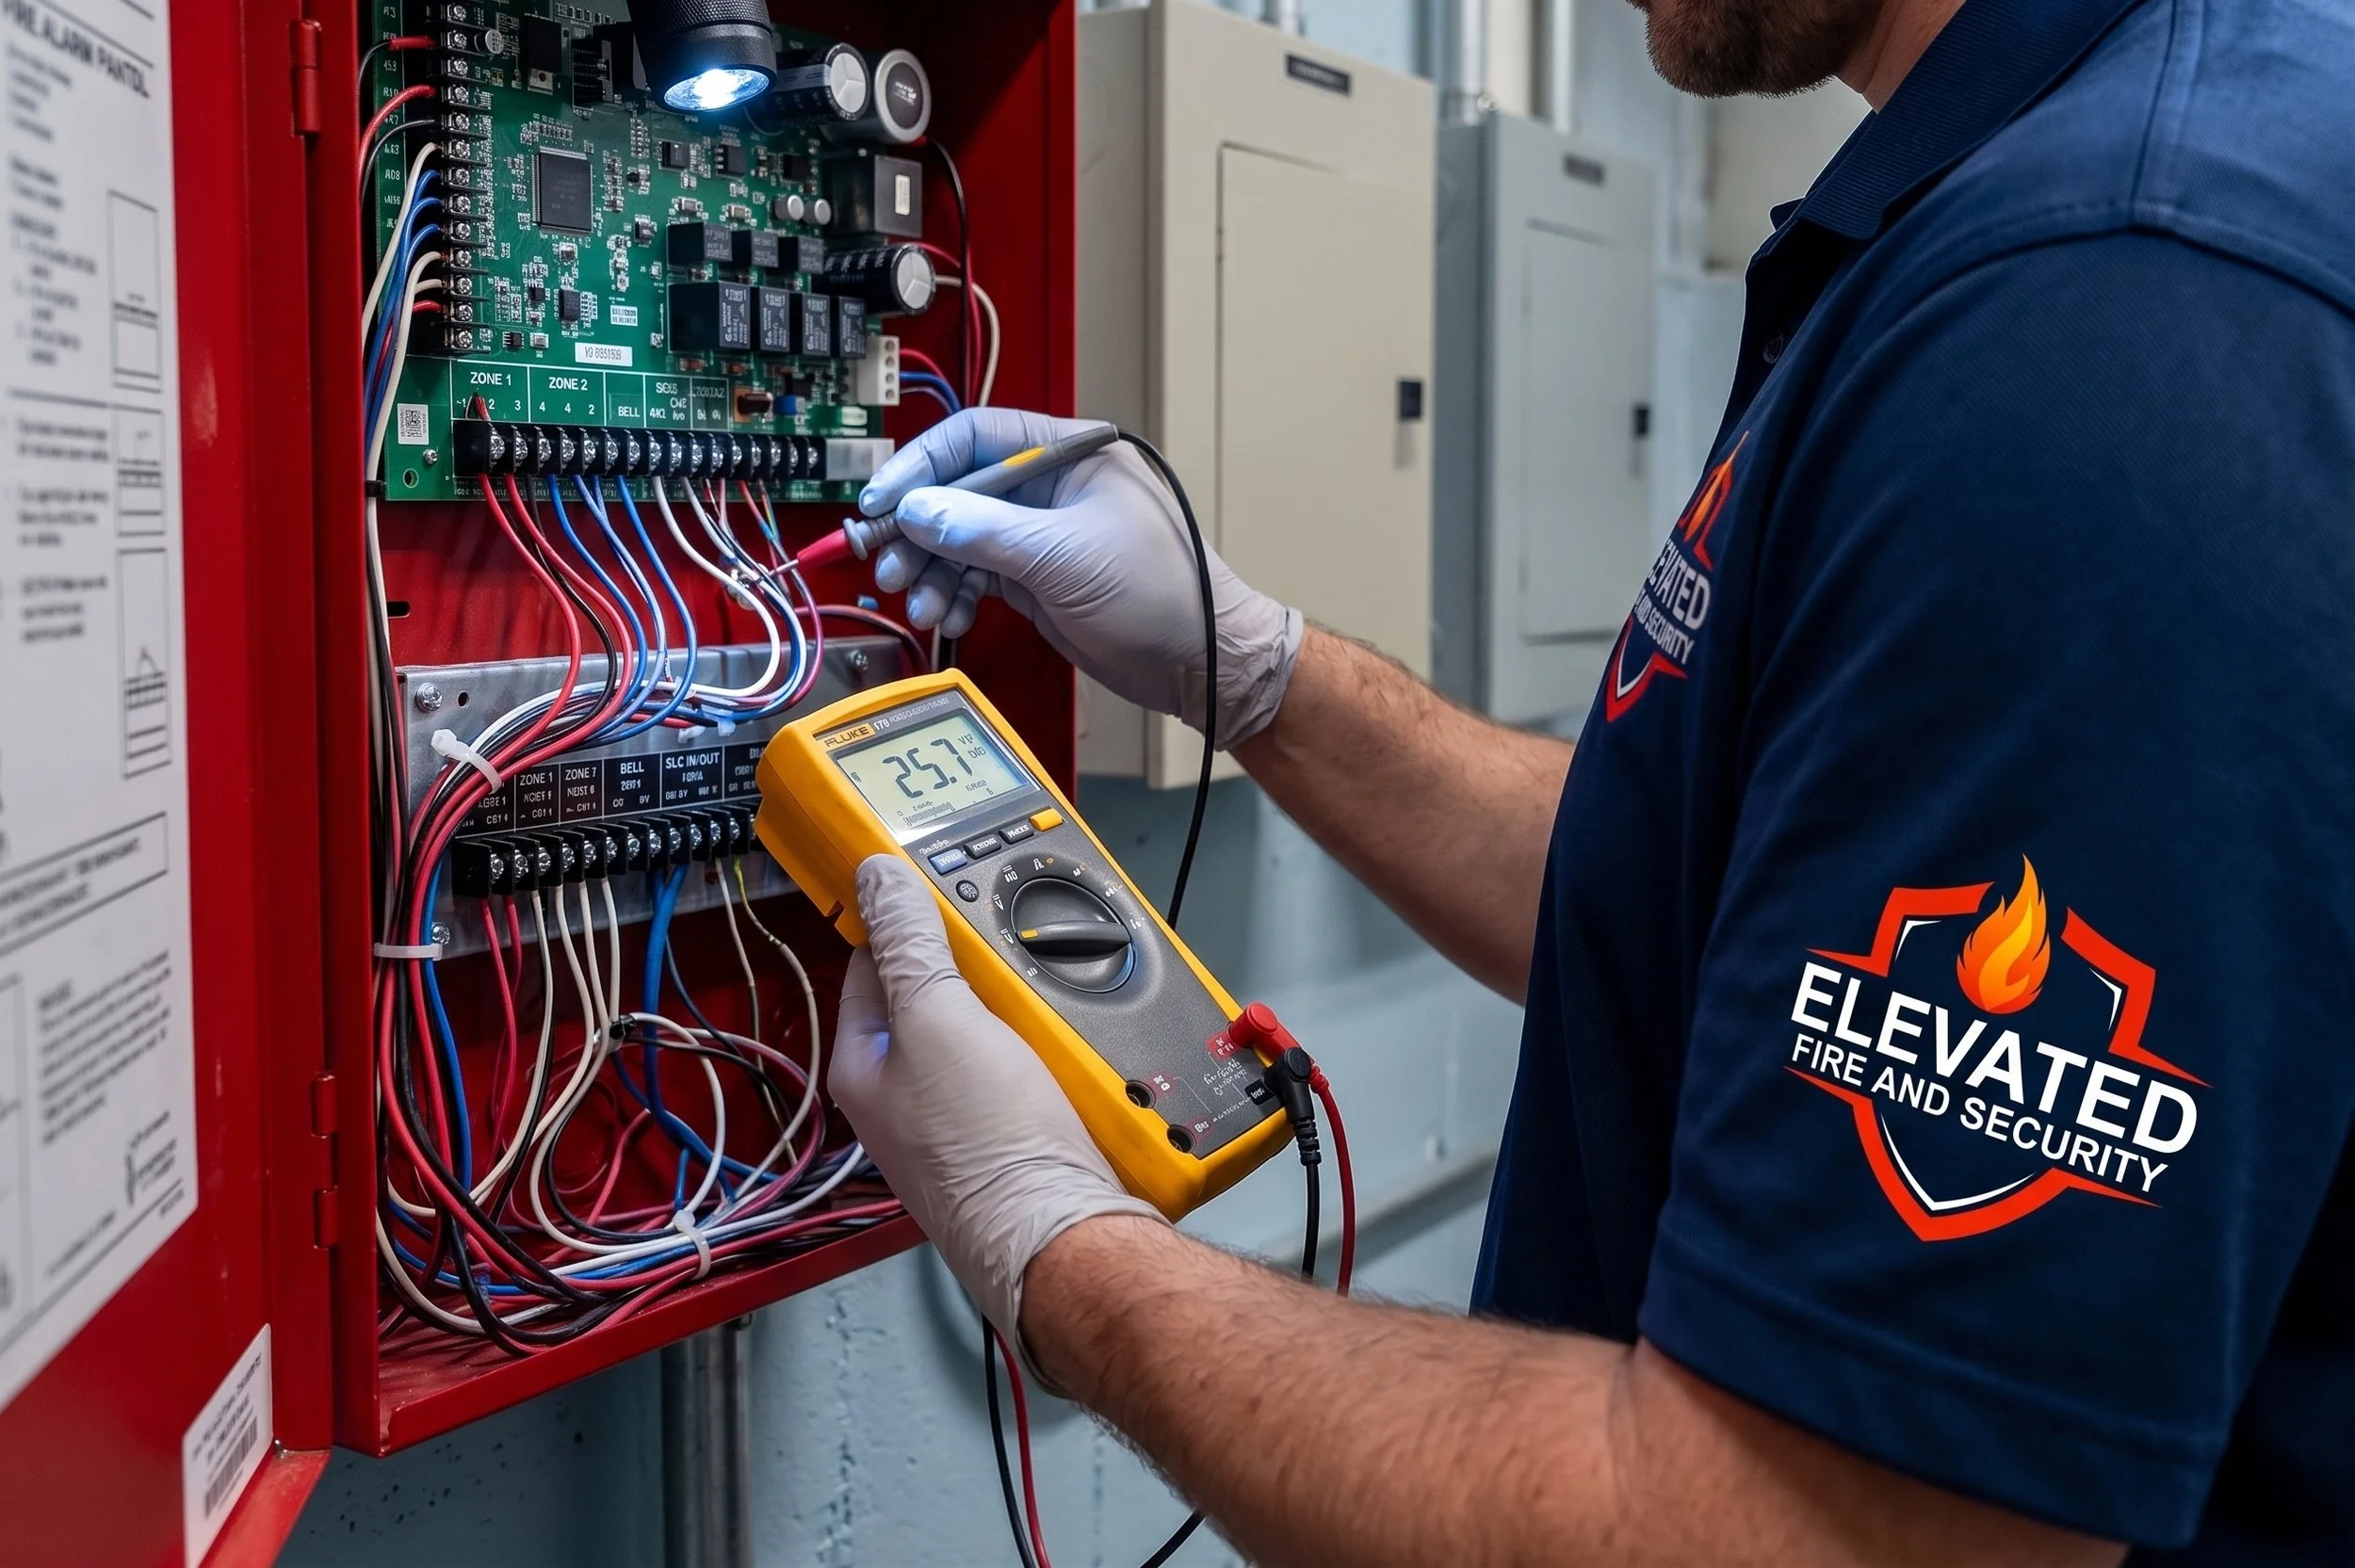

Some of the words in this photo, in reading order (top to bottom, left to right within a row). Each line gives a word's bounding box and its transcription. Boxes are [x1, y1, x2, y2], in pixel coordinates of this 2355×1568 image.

[470, 372, 502, 385] ZONE
[506, 374, 512, 386] 1
[548, 377, 578, 390] ZONE
[580, 379, 588, 391] 2
[488, 398, 495, 410] 2
[514, 399, 521, 411] 3
[539, 401, 546, 412] 4
[564, 403, 572, 413] 4
[588, 404, 594, 414] 2
[618, 406, 641, 417] BELL
[1644, 606, 1695, 665] SECURITY
[824, 726, 869, 748] FLUKE
[620, 761, 644, 774] BELL
[665, 756, 684, 769] SLC
[686, 752, 720, 767] IN/OUT
[565, 768, 590, 781] ZONE
[592, 767, 597, 778] 7
[883, 738, 972, 799] 25.7
[519, 772, 545, 786] ZONE
[548, 771, 554, 784] 1
[1791, 962, 2197, 1154] ELEVATED
[1792, 1033, 1867, 1087] FIRE
[1871, 1067, 1950, 1116] AND
[1959, 1097, 2168, 1192] SECURITY
